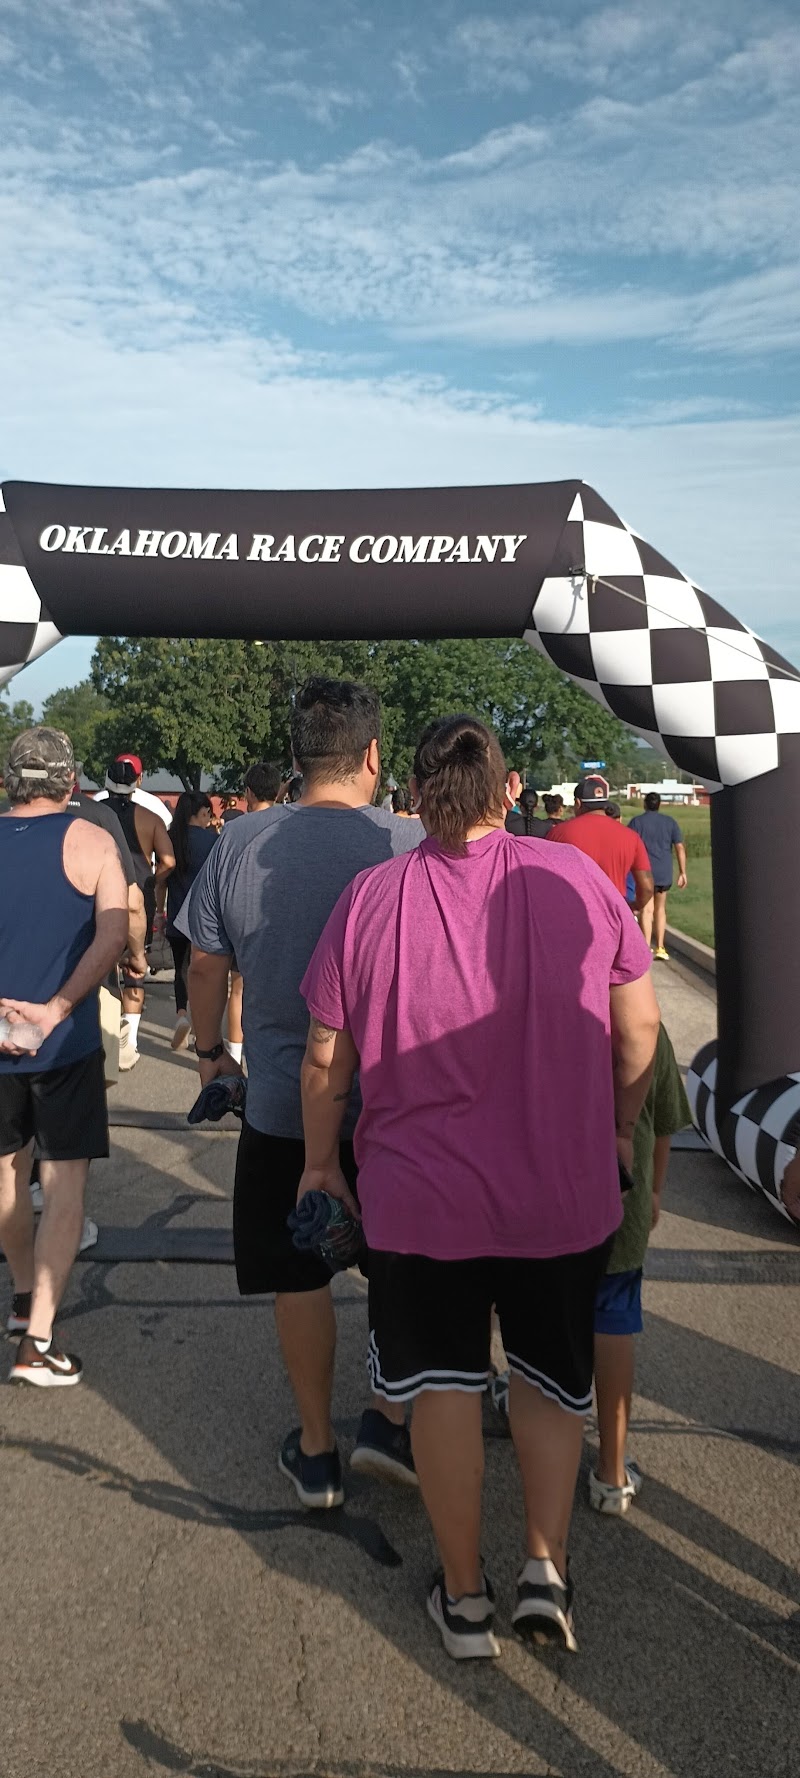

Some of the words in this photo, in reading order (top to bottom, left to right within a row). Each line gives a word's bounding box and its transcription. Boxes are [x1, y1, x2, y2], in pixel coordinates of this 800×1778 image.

[39, 524, 240, 561] OKLAHOMA
[246, 534, 346, 563] RACE
[349, 534, 528, 563] COMPANY
